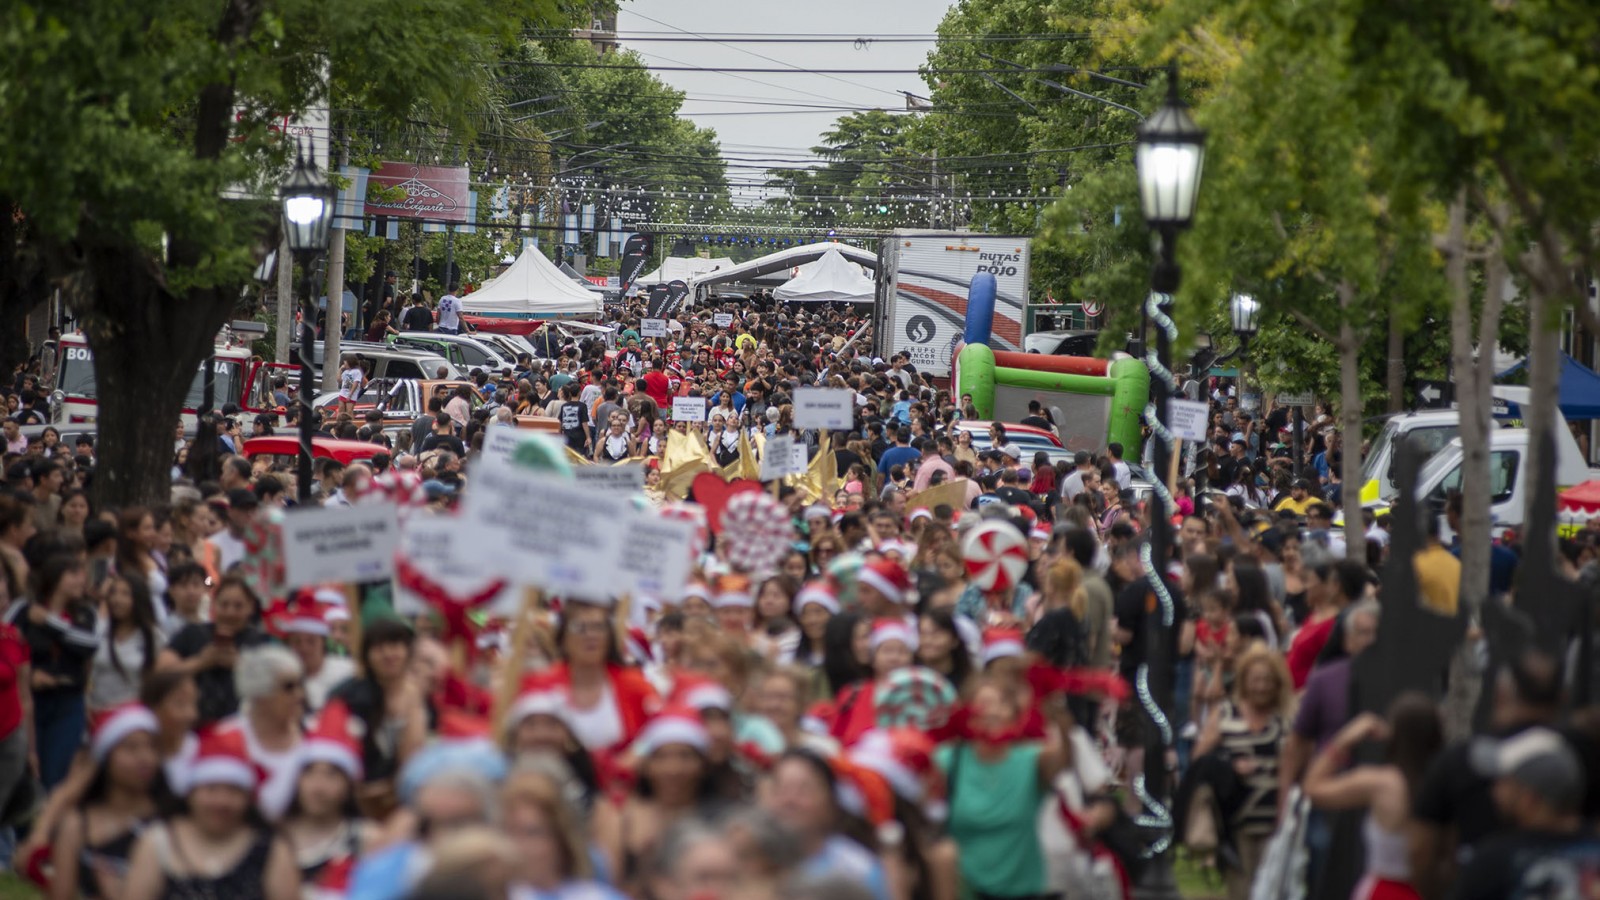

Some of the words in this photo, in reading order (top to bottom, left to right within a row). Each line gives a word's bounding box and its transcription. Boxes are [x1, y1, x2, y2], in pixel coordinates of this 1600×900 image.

[616, 211, 647, 220] NOBLE
[979, 252, 1021, 262] RUTAS
[627, 259, 646, 283] YOKOHAMA
[976, 265, 1018, 277] ROJO
[654, 294, 671, 318] YOKOHAMA
[666, 291, 687, 314] YOKOHAMA
